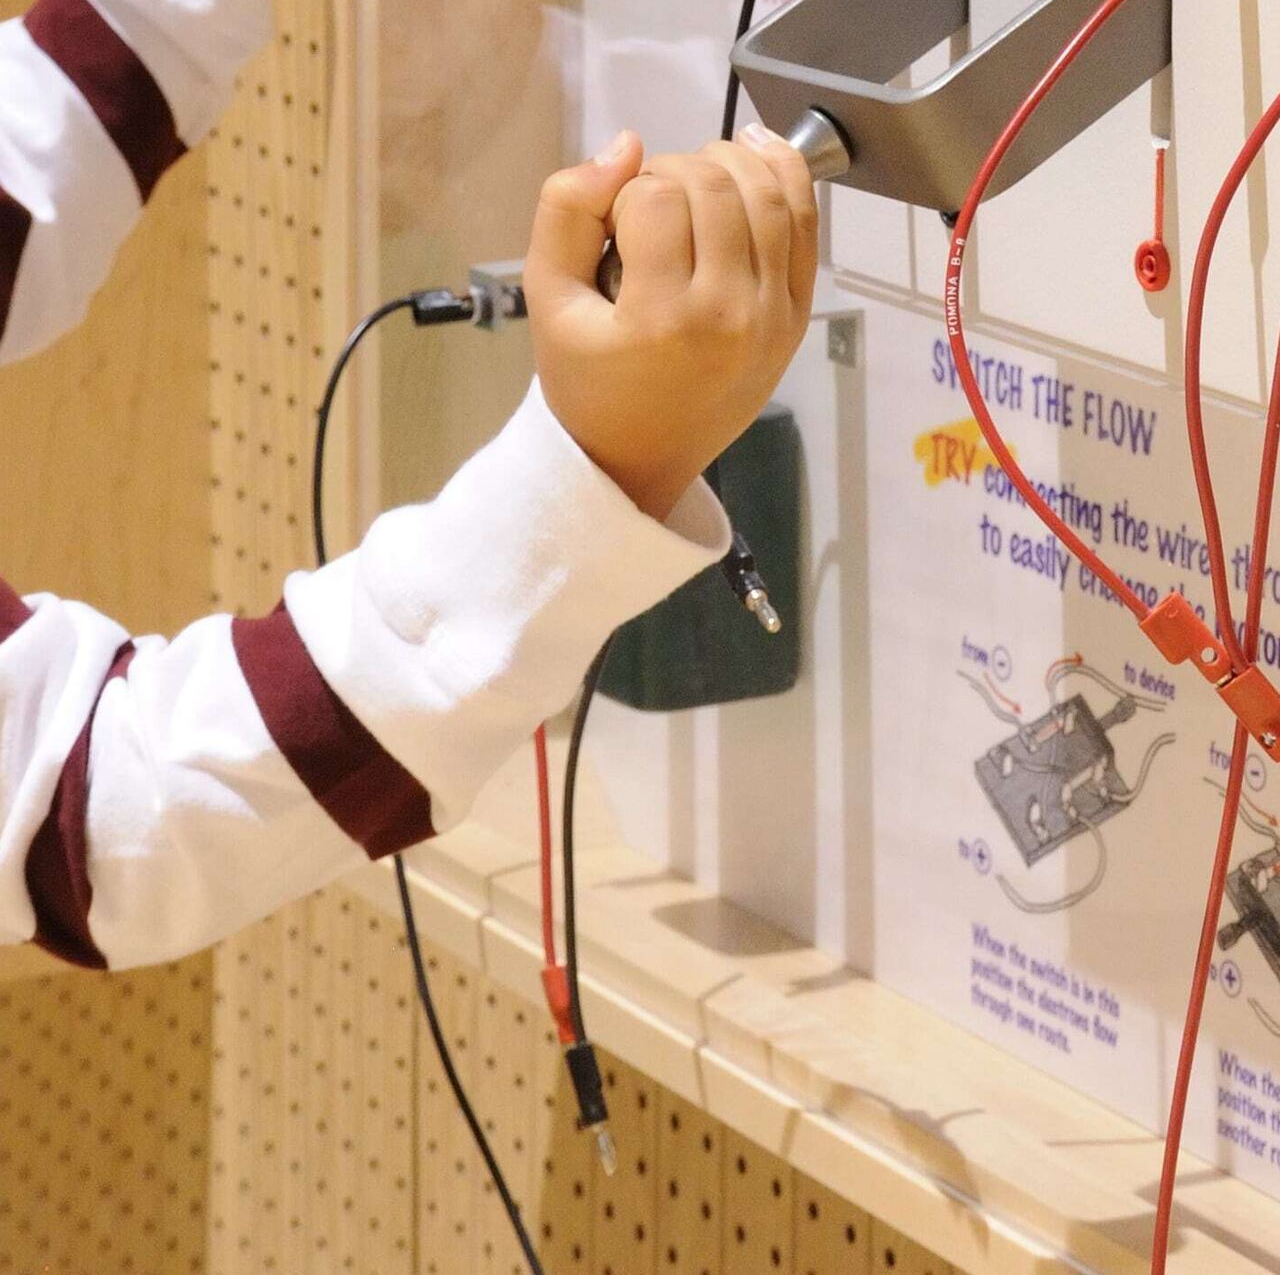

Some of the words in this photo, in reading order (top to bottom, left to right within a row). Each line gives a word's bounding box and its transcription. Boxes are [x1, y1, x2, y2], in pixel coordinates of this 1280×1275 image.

[946, 276, 960, 336] POMONA
[1031, 374, 1076, 429] THE
[1082, 390, 1157, 456] FLOW
[931, 432, 978, 486] TRY
[982, 463, 1103, 544] conecting
[1111, 499, 1150, 553] the
[1155, 522, 1212, 577] wire
[978, 513, 1003, 557] to
[1009, 532, 1071, 592] easily
[1124, 660, 1136, 686] to
[1139, 668, 1176, 701] device
[1210, 740, 1232, 771] fro
[1219, 1047, 1258, 1089] When
[1217, 1085, 1267, 1126] position
[1217, 1117, 1267, 1158] another
